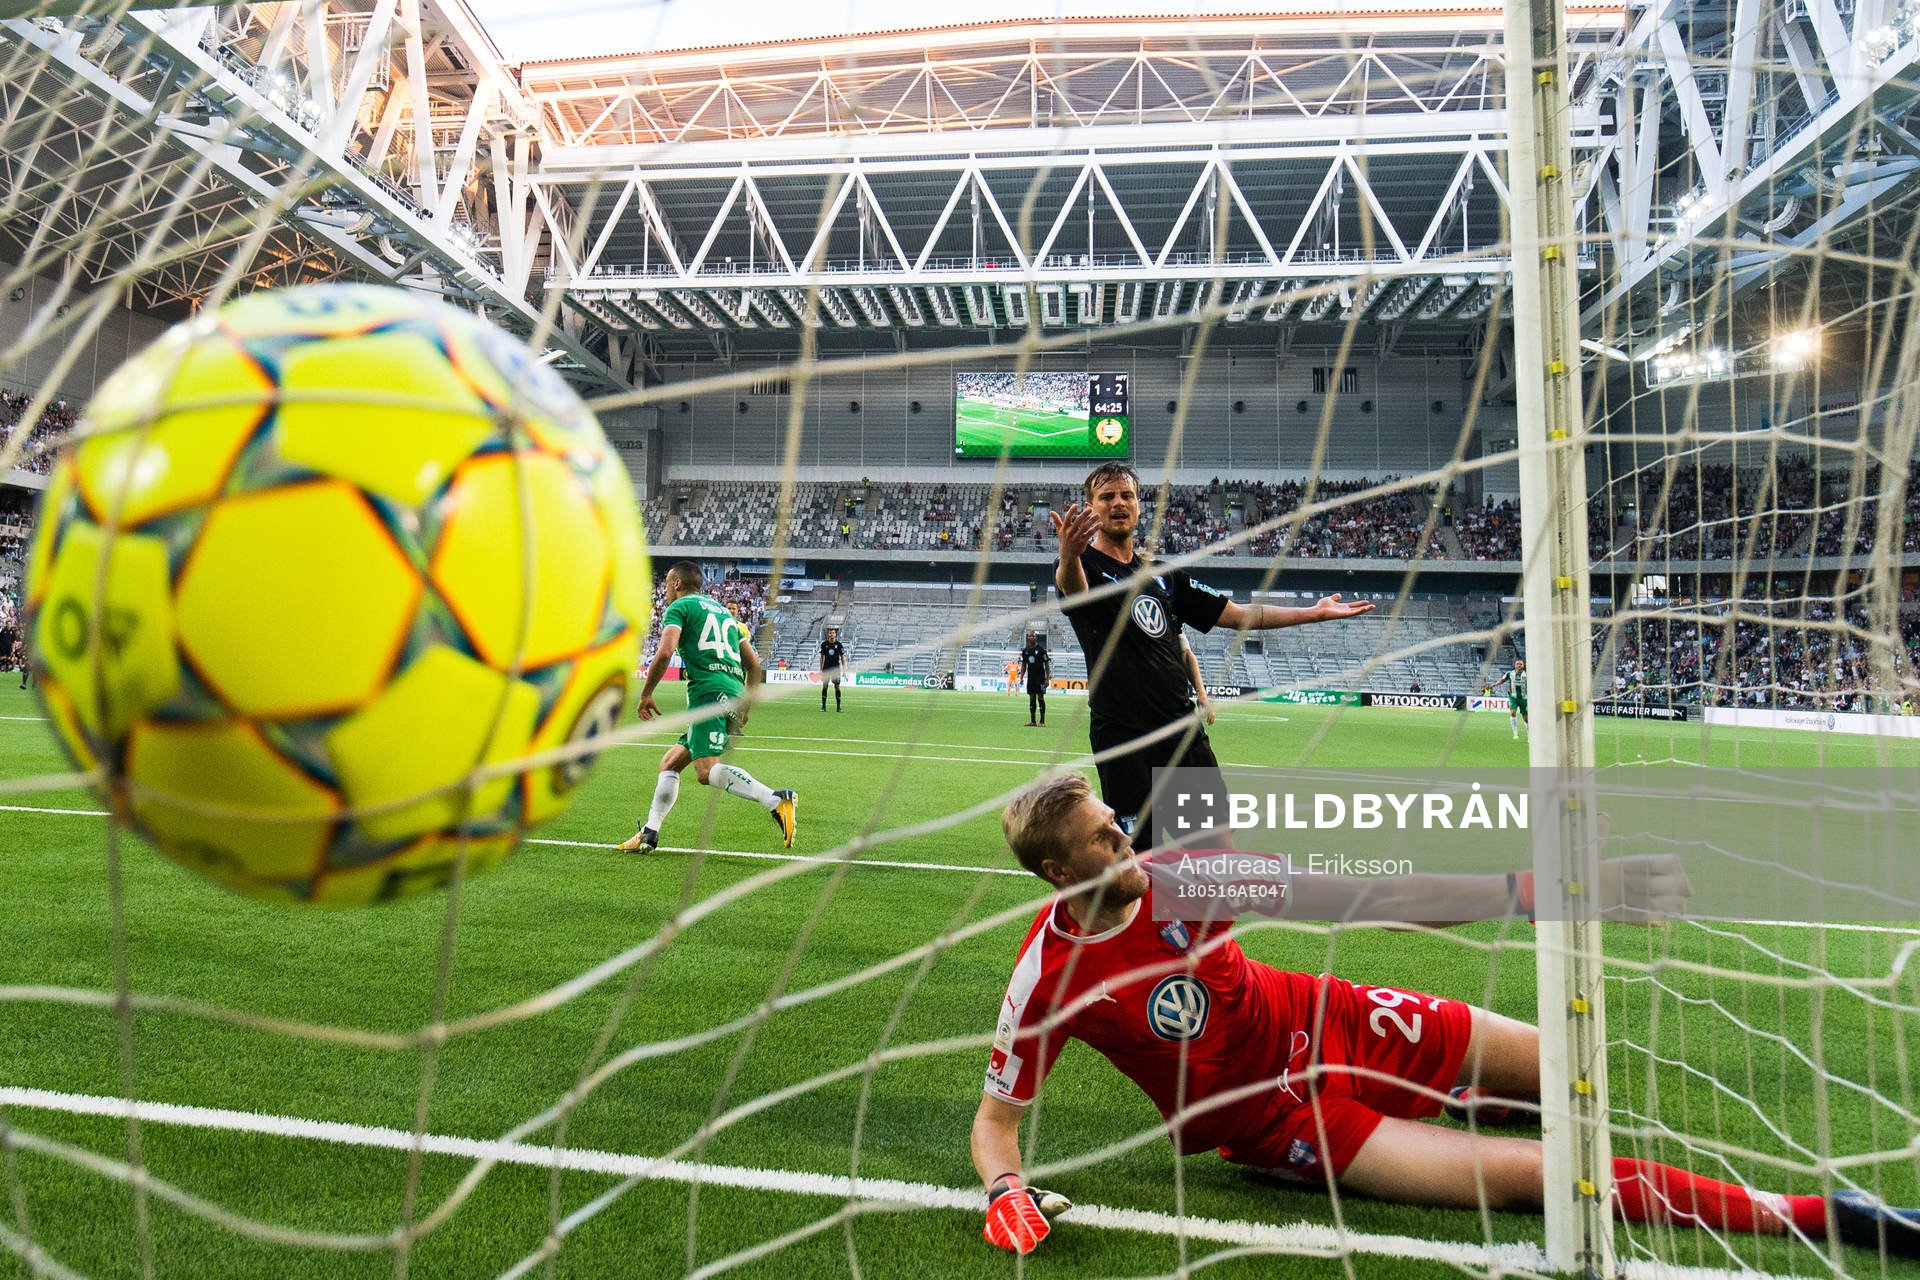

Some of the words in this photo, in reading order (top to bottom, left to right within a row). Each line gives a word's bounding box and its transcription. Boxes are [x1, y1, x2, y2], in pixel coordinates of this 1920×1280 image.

[1094, 384, 1100, 395] 1
[1115, 384, 1123, 395] 2
[1095, 403, 1122, 413] 64:25
[614, 440, 643, 450] rena
[698, 612, 741, 661] 40
[773, 672, 808, 681] PELIKAN
[858, 675, 922, 687] AudicomPendax
[1192, 686, 1240, 696] FECON
[1371, 694, 1457, 708] METODGOLV
[1366, 987, 1422, 1044] 29
